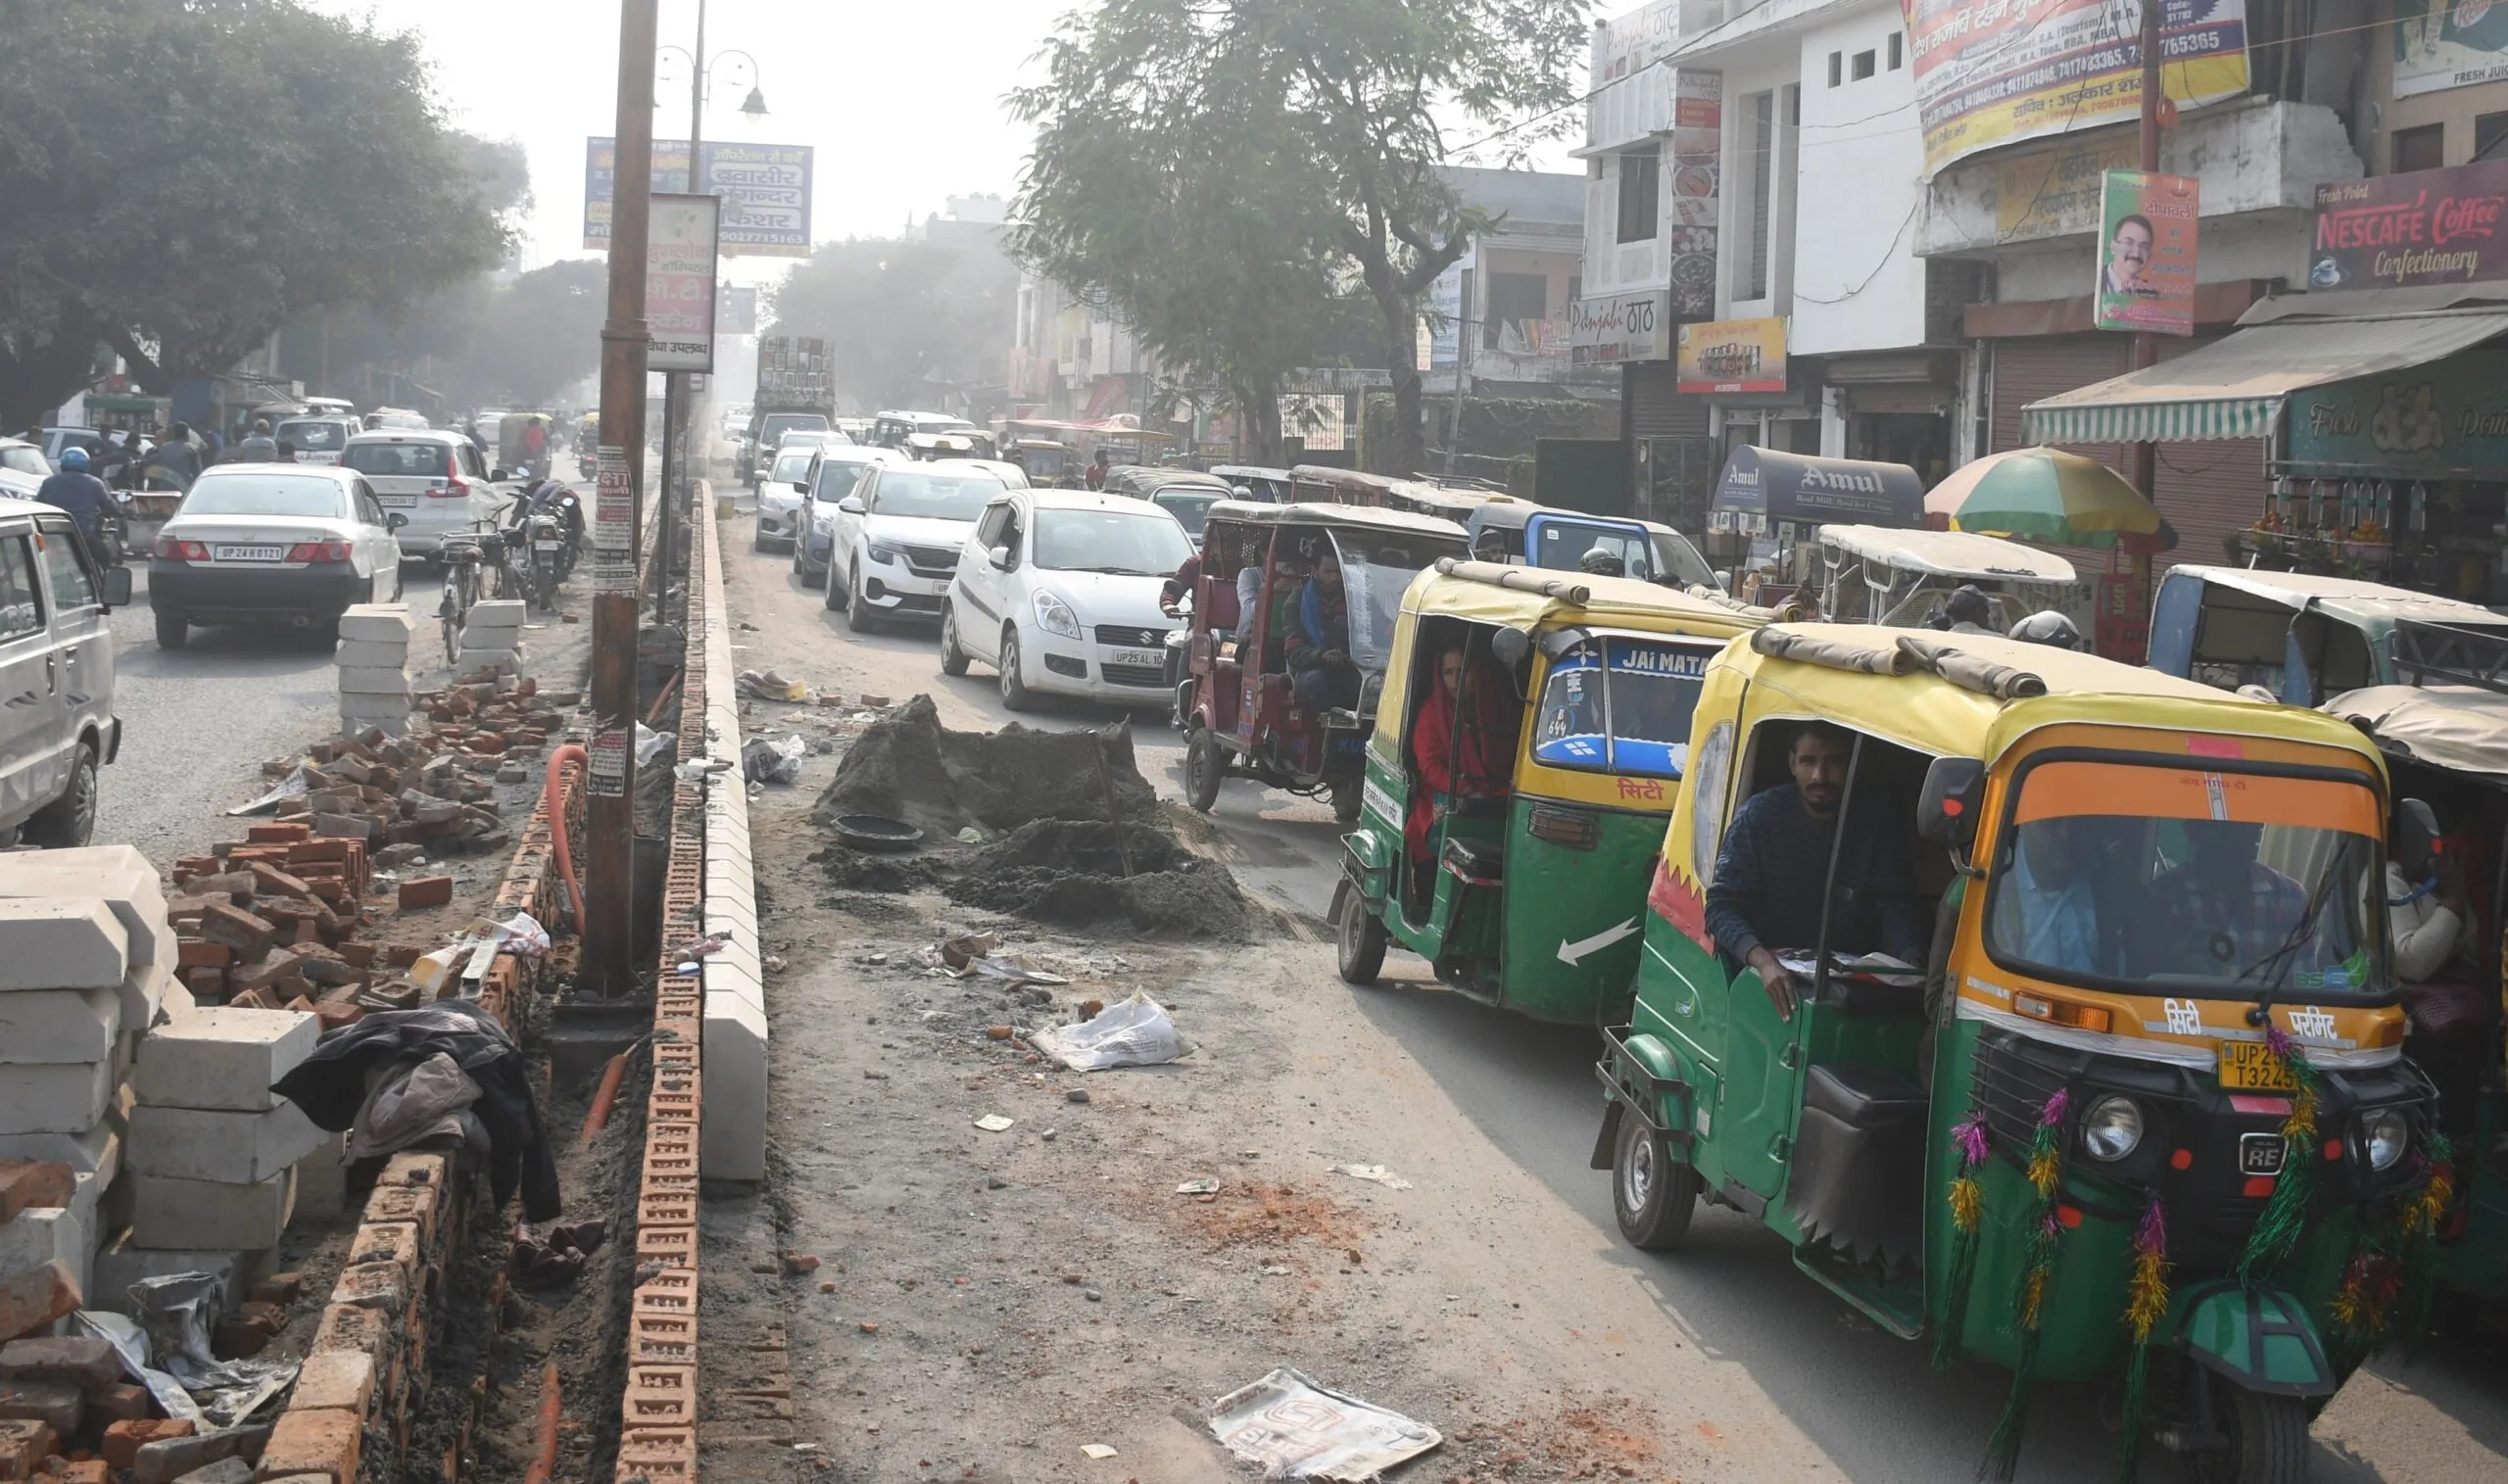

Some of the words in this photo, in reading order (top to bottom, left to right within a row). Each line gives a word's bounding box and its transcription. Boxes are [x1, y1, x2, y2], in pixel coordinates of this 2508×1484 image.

[2454, 69, 2485, 84] FRESH
[2318, 187, 2342, 204] Fresh
[2343, 184, 2369, 200] Point
[2433, 196, 2505, 245] Coffee
[2374, 249, 2479, 282] Confectionery
[1571, 300, 1623, 342] Punjabi
[1727, 464, 1760, 486] Amul
[1801, 463, 1886, 494] Amul
[222, 549, 234, 558] UP
[236, 549, 247, 558] 24
[1117, 651, 1138, 663] UP25
[1548, 720, 1567, 737] 644
[1616, 777, 1664, 802] सिटी
[2163, 997, 2201, 1035] सिटी
[2289, 1005, 2338, 1040] परमिट
[2247, 1148, 2280, 1167] RE
